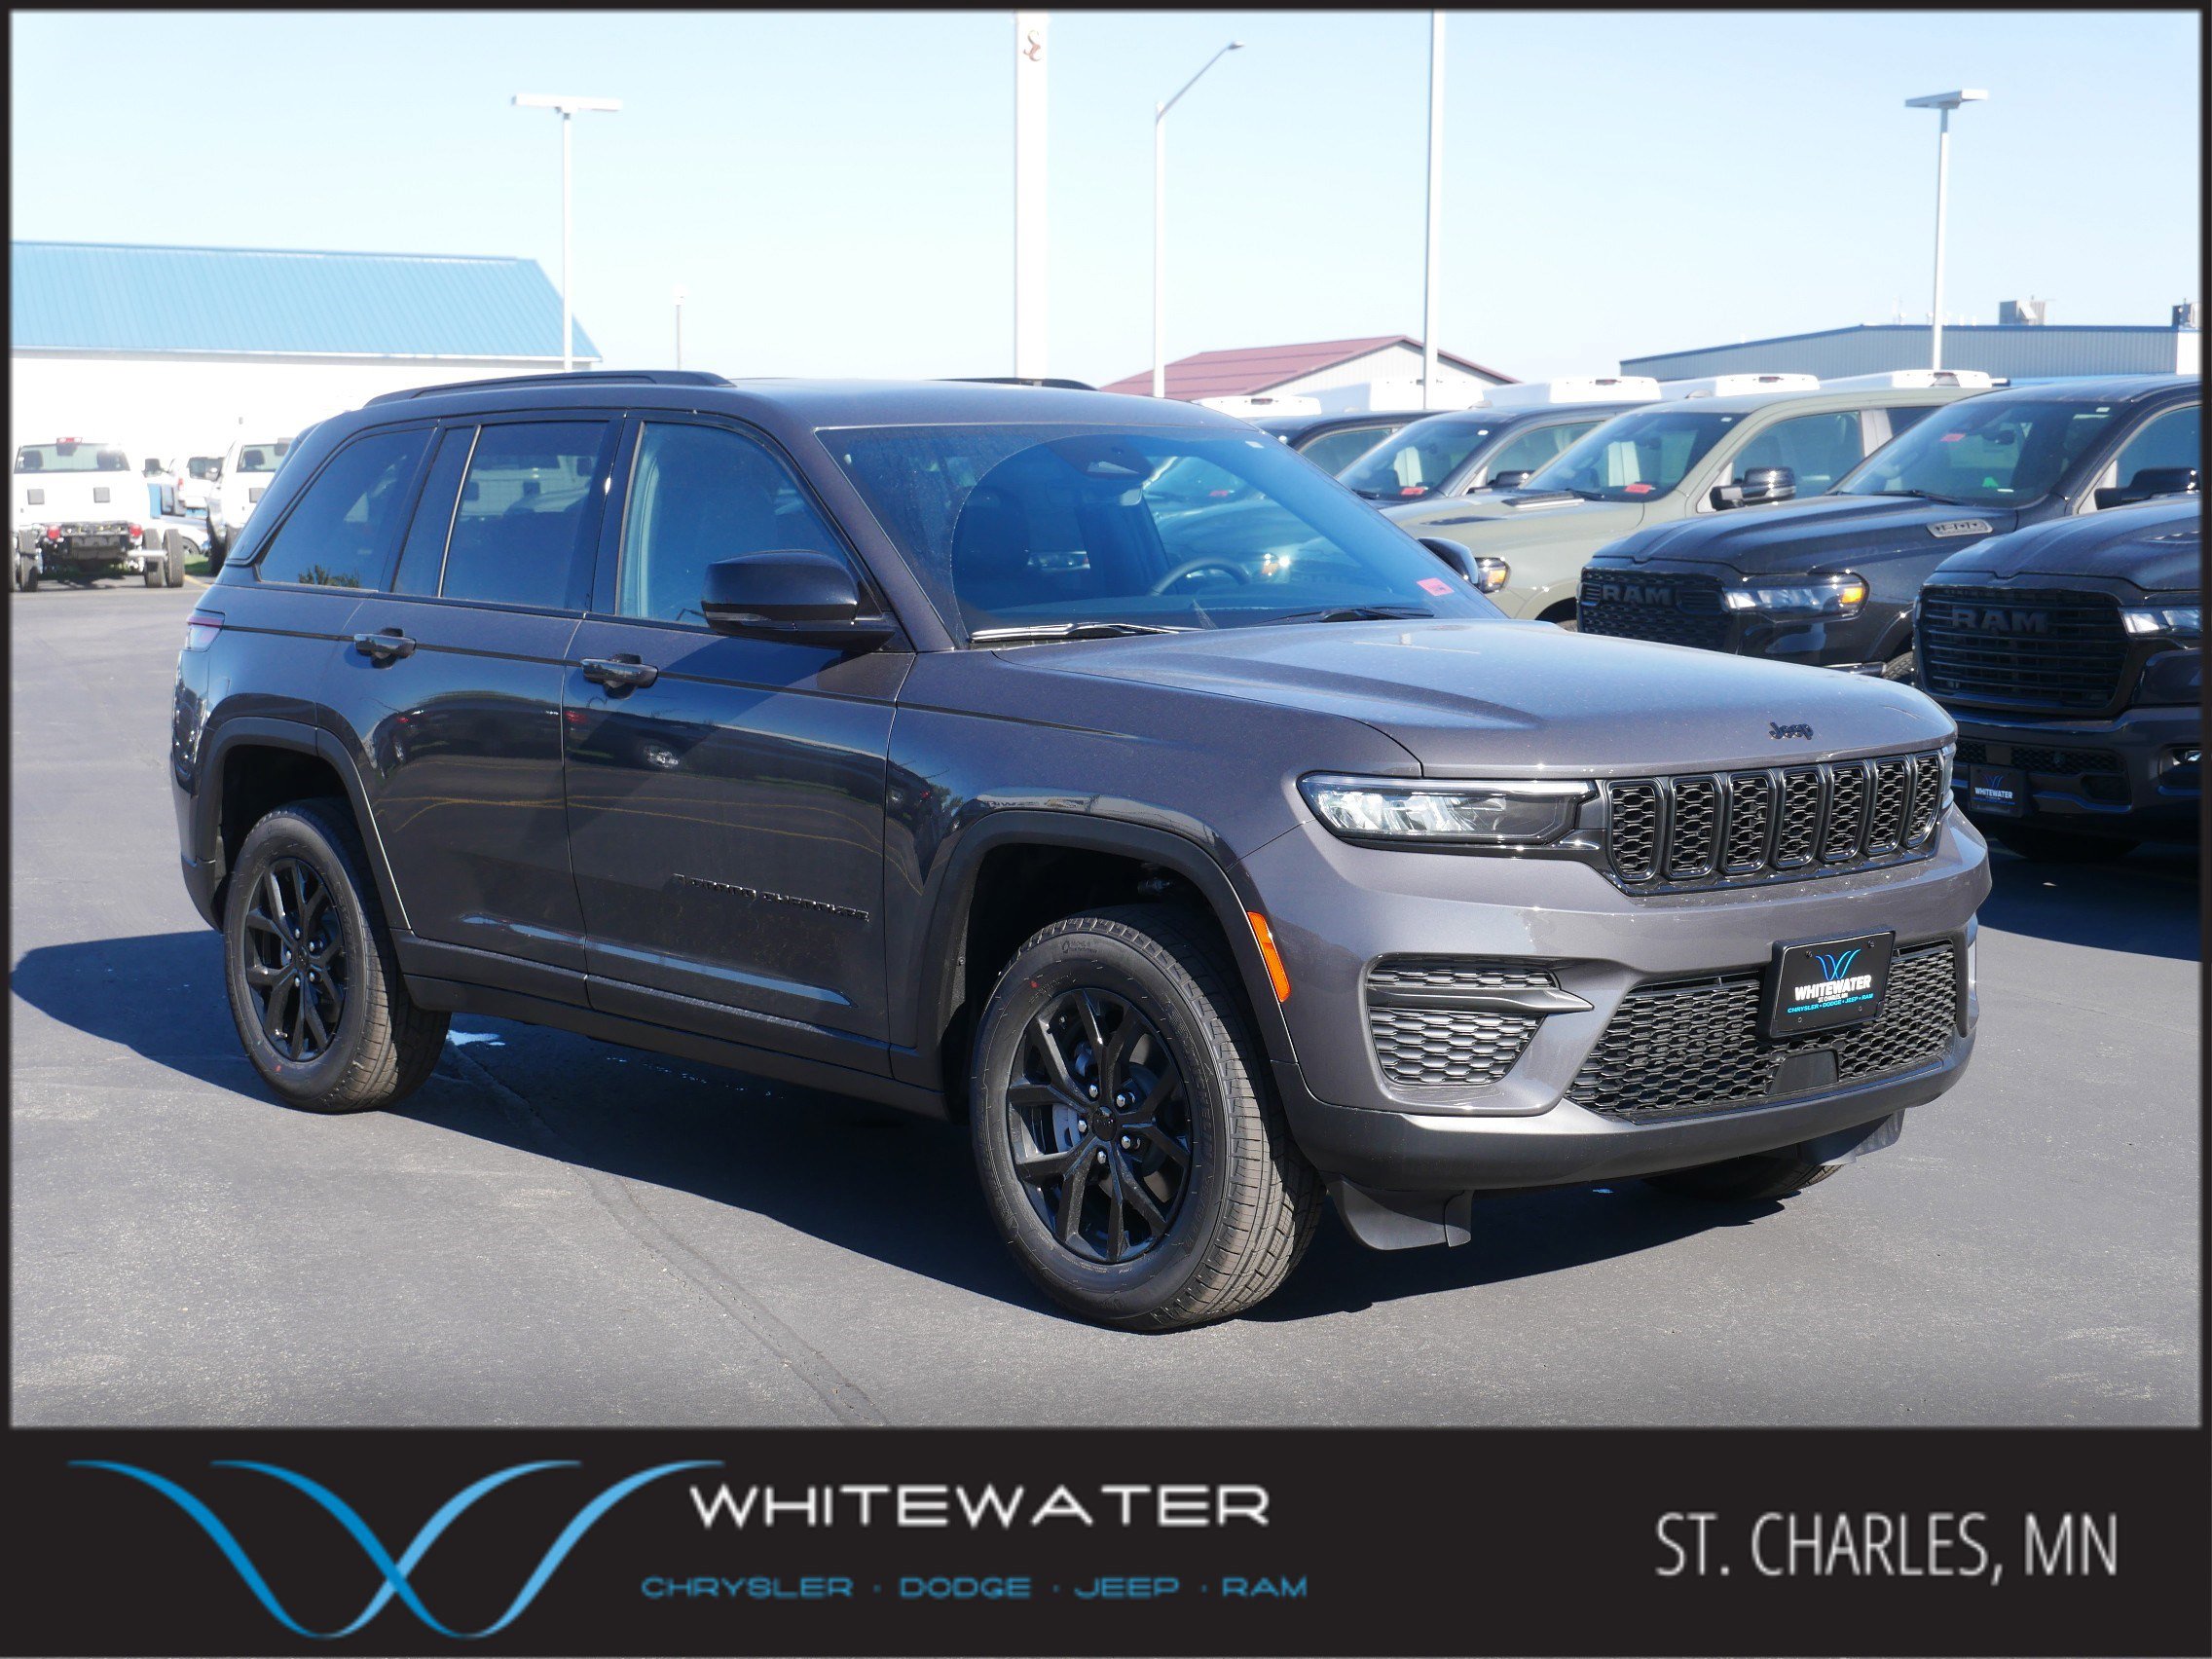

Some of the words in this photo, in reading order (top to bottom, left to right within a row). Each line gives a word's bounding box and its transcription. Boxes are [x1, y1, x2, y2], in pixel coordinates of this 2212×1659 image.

[1603, 585, 1674, 605] RAM
[1952, 608, 2047, 633] RAM
[1769, 721, 1814, 740] Jeep
[1974, 787, 2013, 798] WHITEWATER
[1794, 975, 1871, 1001] WHITEWATER
[1788, 1004, 1819, 1013] CHRYSLER
